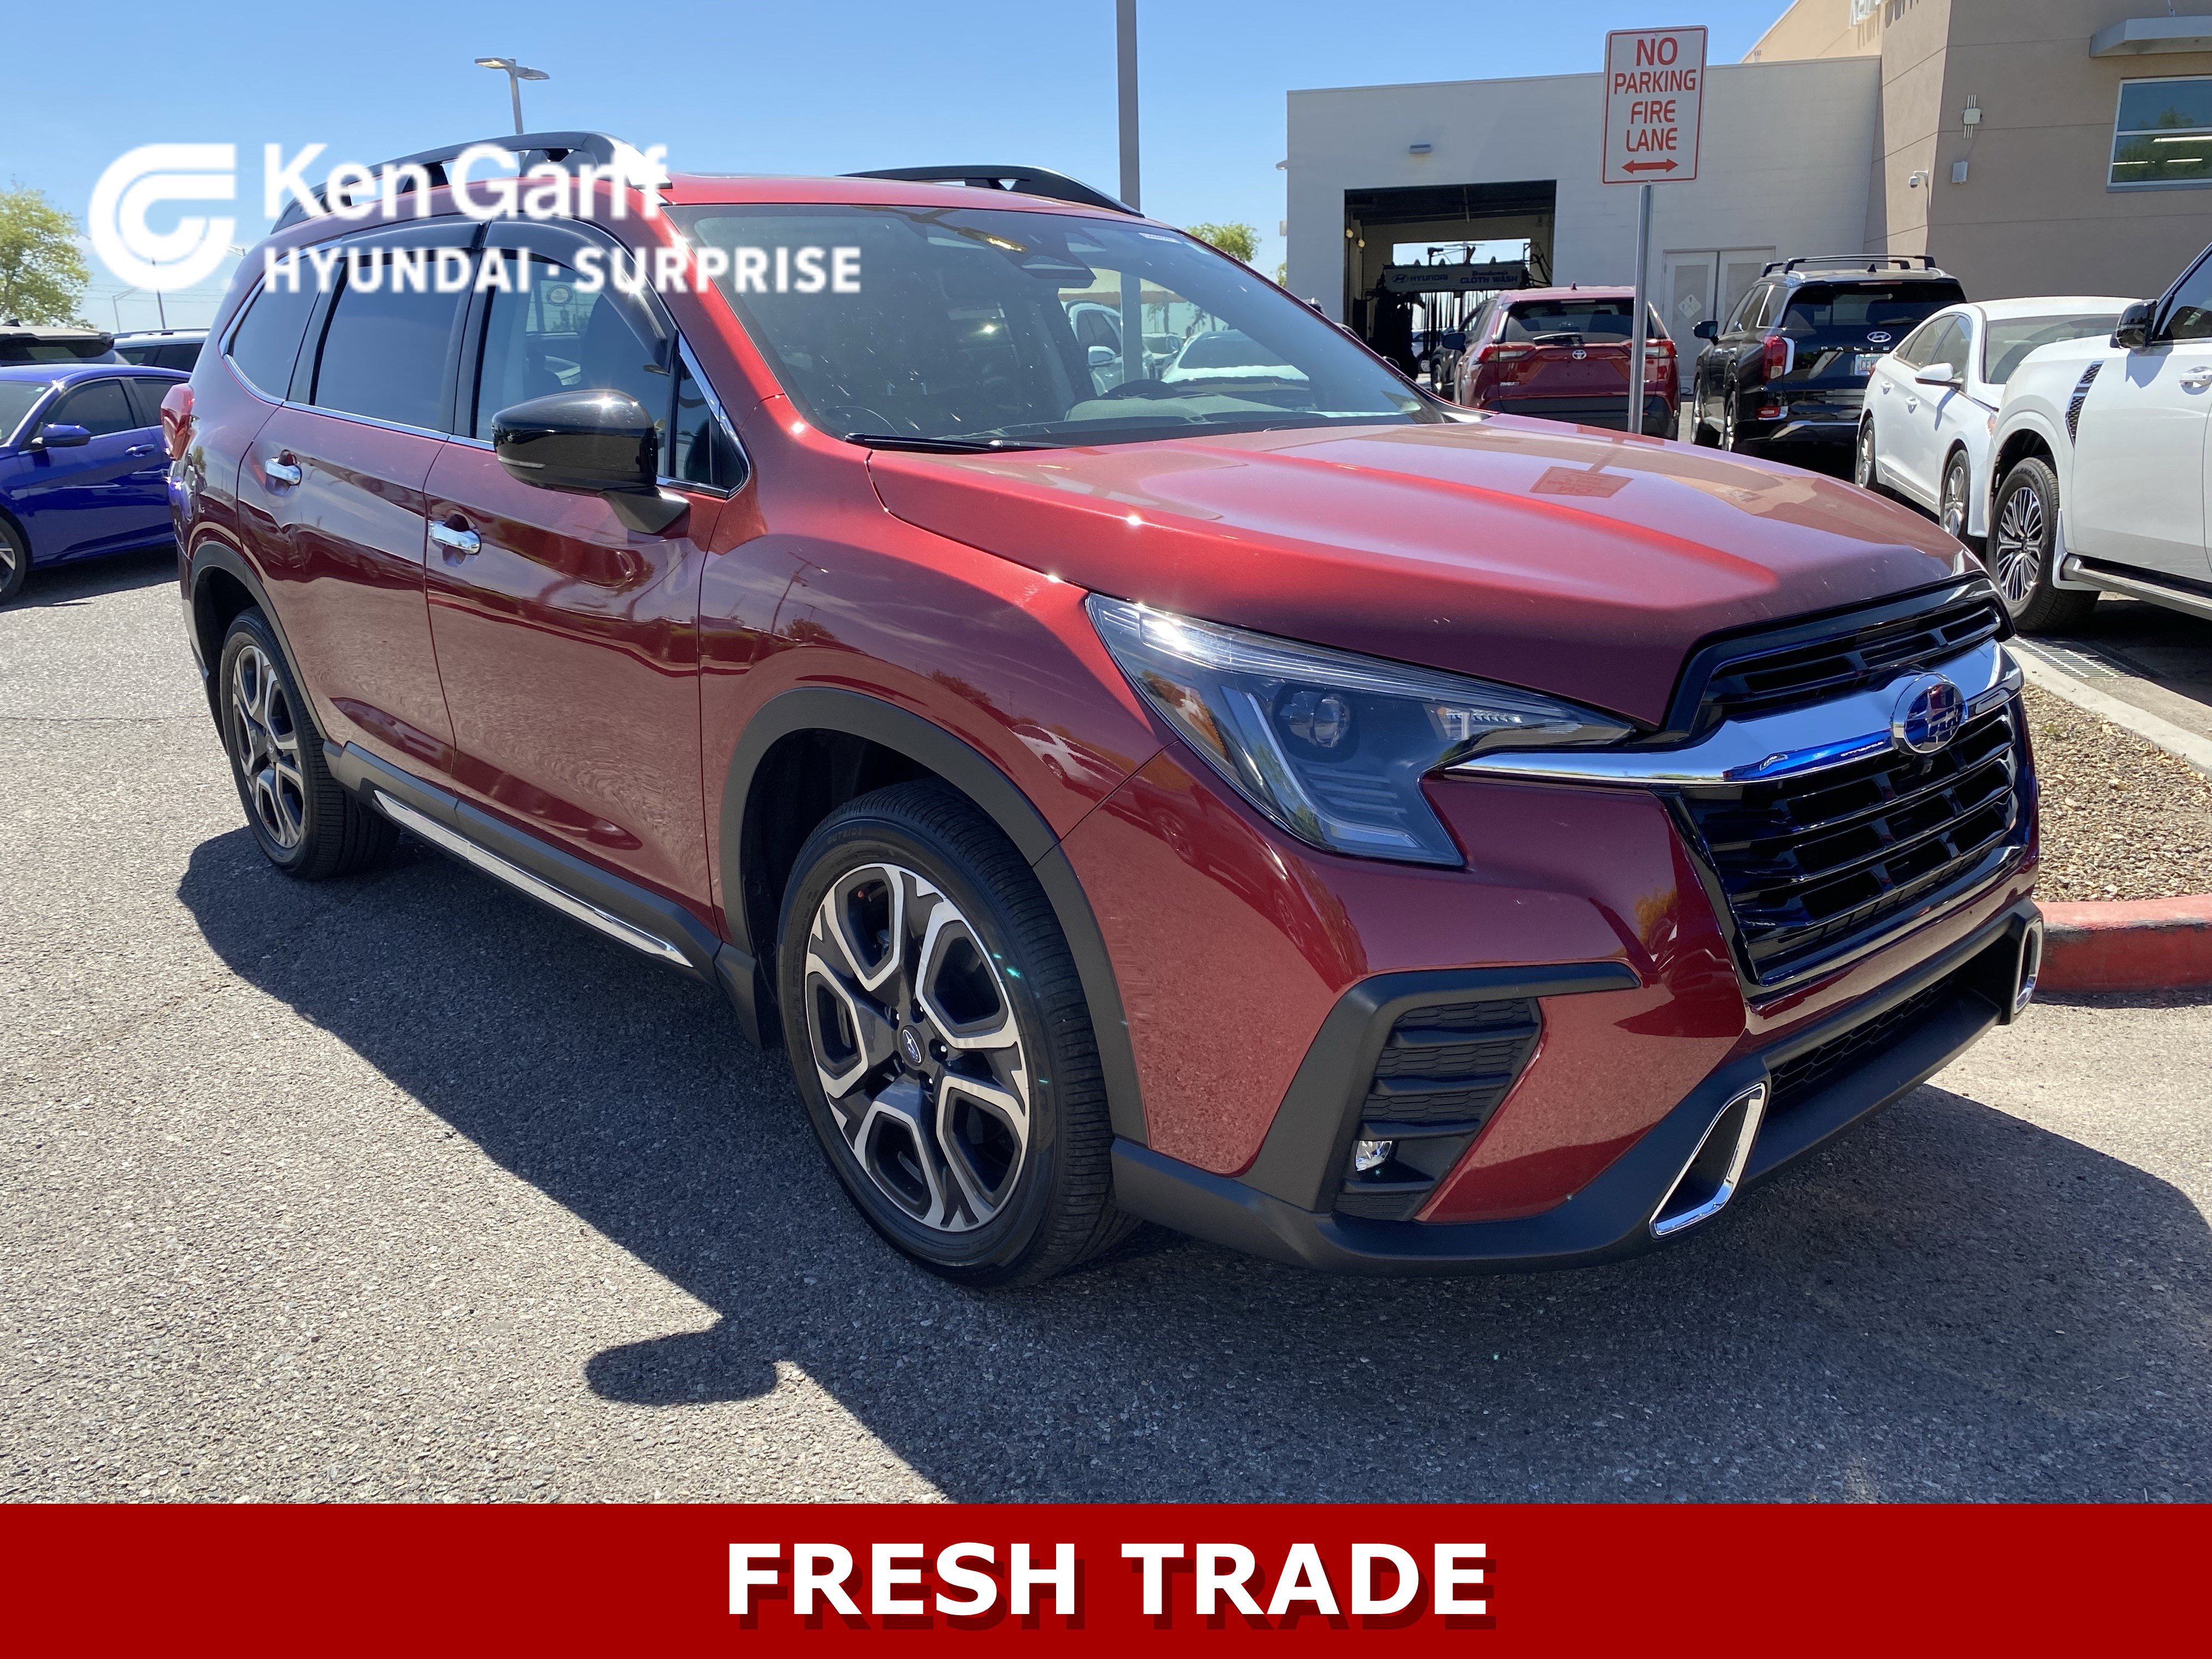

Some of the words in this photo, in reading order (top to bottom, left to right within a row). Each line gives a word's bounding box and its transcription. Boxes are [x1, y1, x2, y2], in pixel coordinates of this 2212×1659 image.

[1636, 37, 1678, 66] NO
[1613, 69, 1697, 95] PARKING
[1630, 99, 1676, 125] FIRE
[1626, 127, 1678, 152] LANE
[1460, 276, 1489, 284] CLOTH
[1493, 275, 1518, 283] WASH
